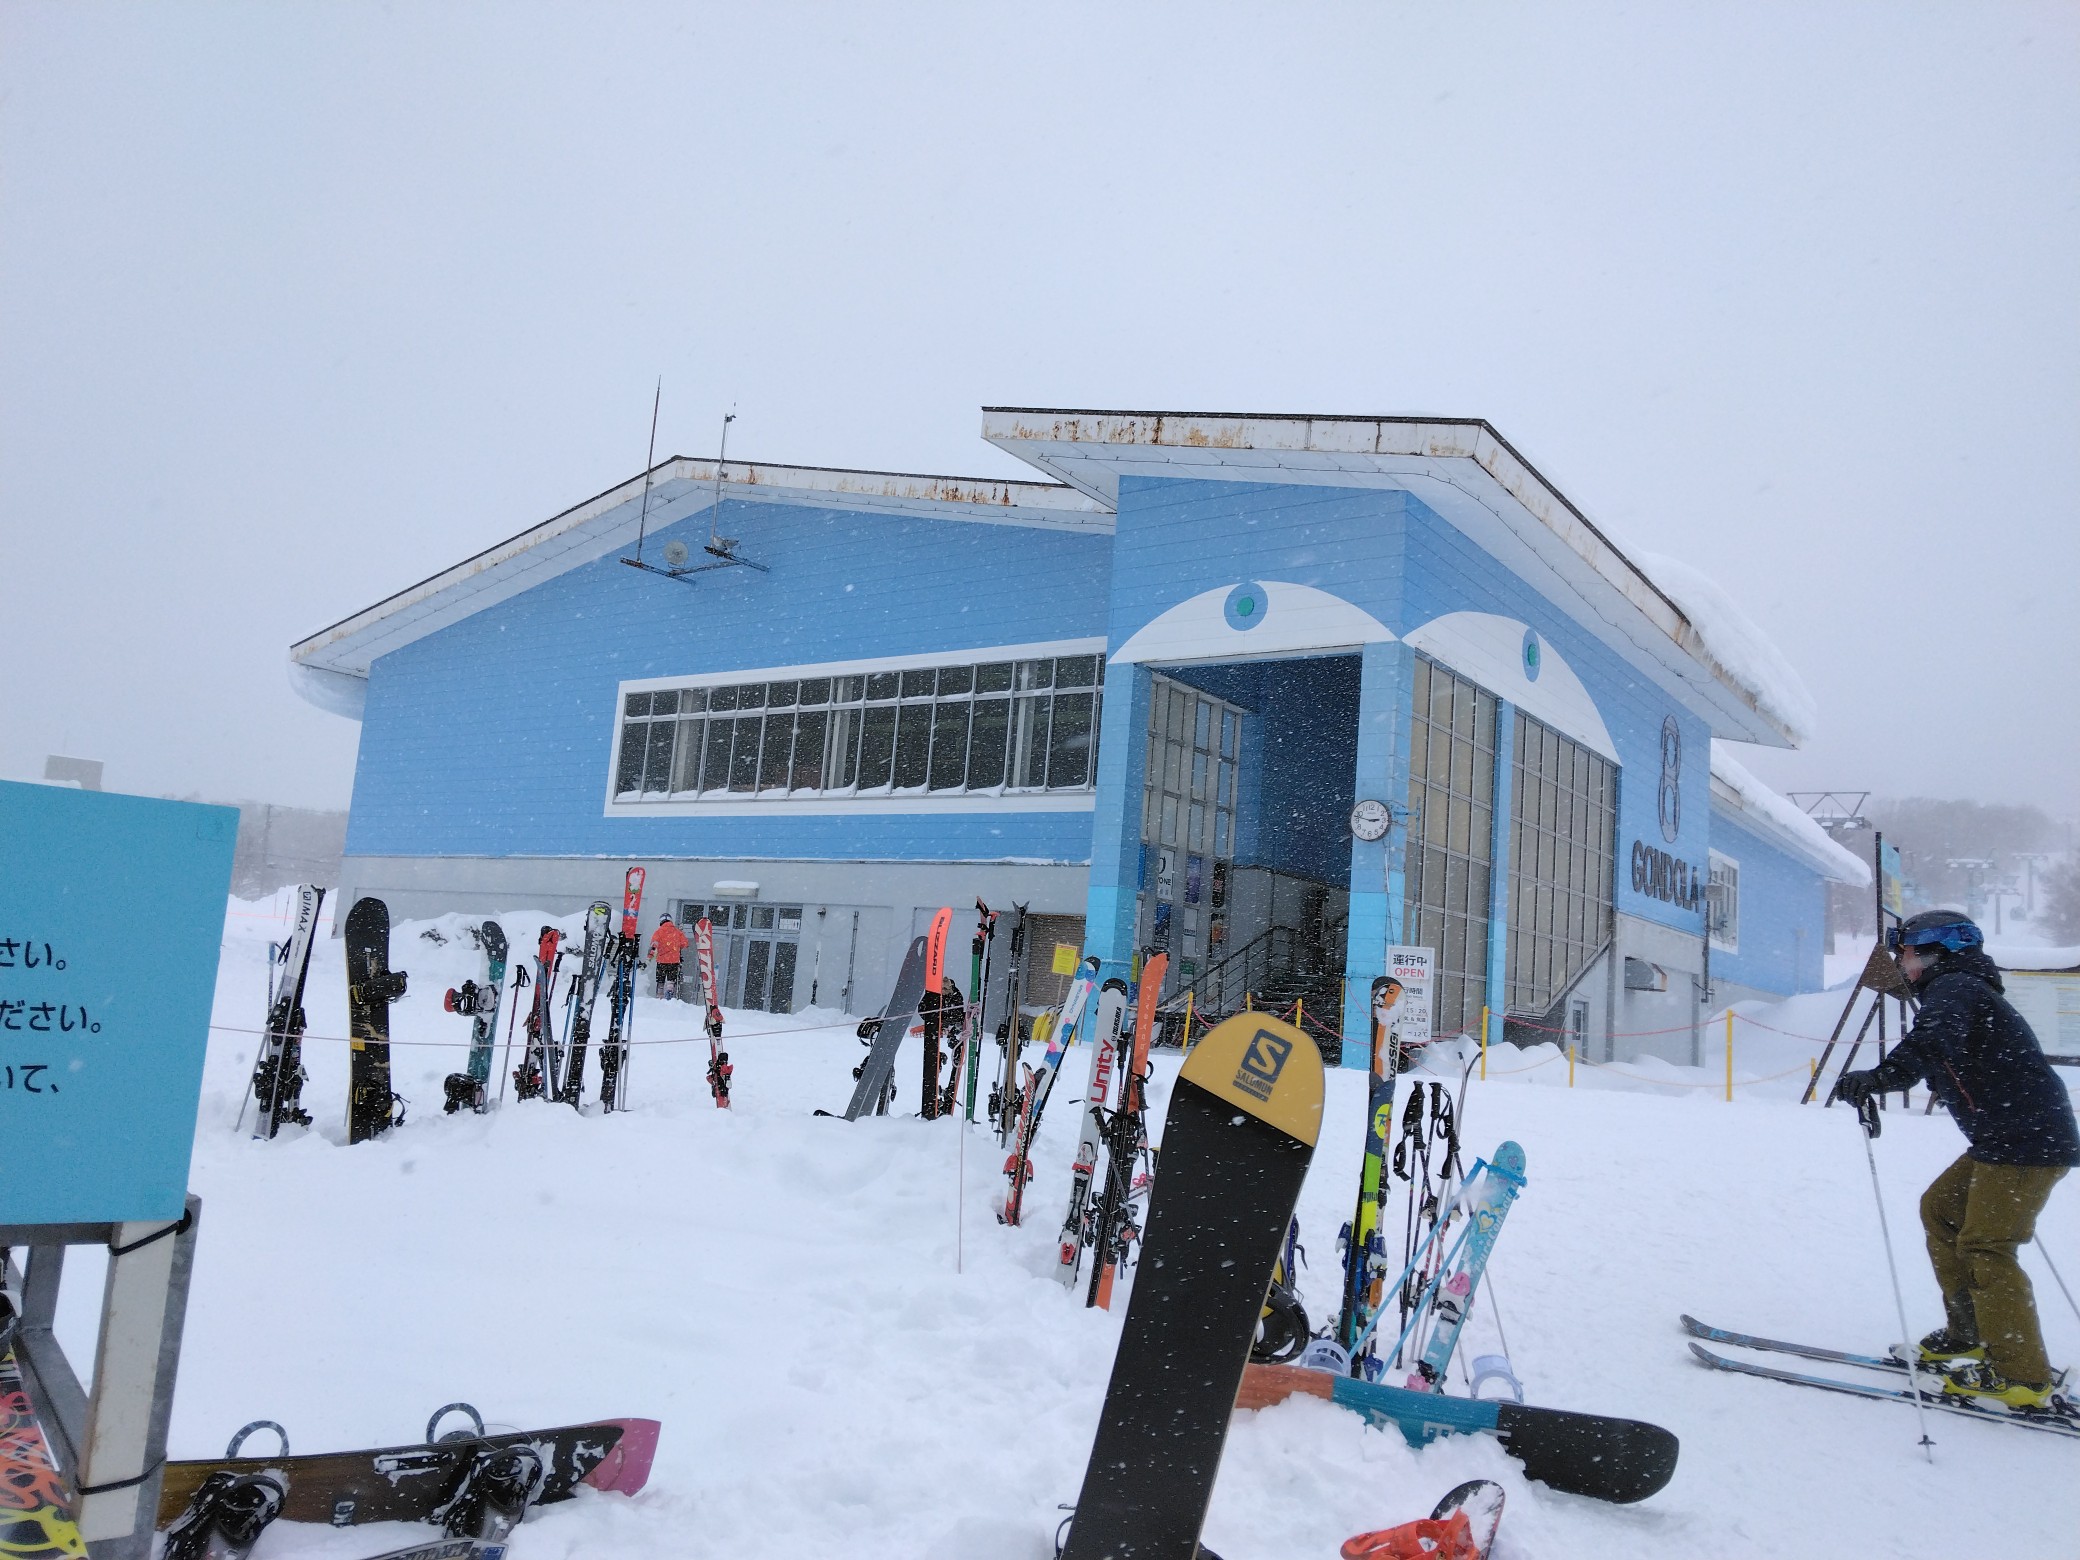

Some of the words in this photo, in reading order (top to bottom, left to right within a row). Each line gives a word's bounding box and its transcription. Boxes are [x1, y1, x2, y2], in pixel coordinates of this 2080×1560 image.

[1631, 840, 1699, 913] GONDOLA
[588, 932, 600, 969] SALOMO
[932, 917, 945, 975] BLIZZARD
[1393, 954, 1427, 966] 運行中
[1394, 968, 1425, 978] OPEN
[1112, 1006, 1122, 1037] OGASAKA
[1091, 1039, 1114, 1102] Unity
[1235, 1069, 1273, 1096] SALOMON
